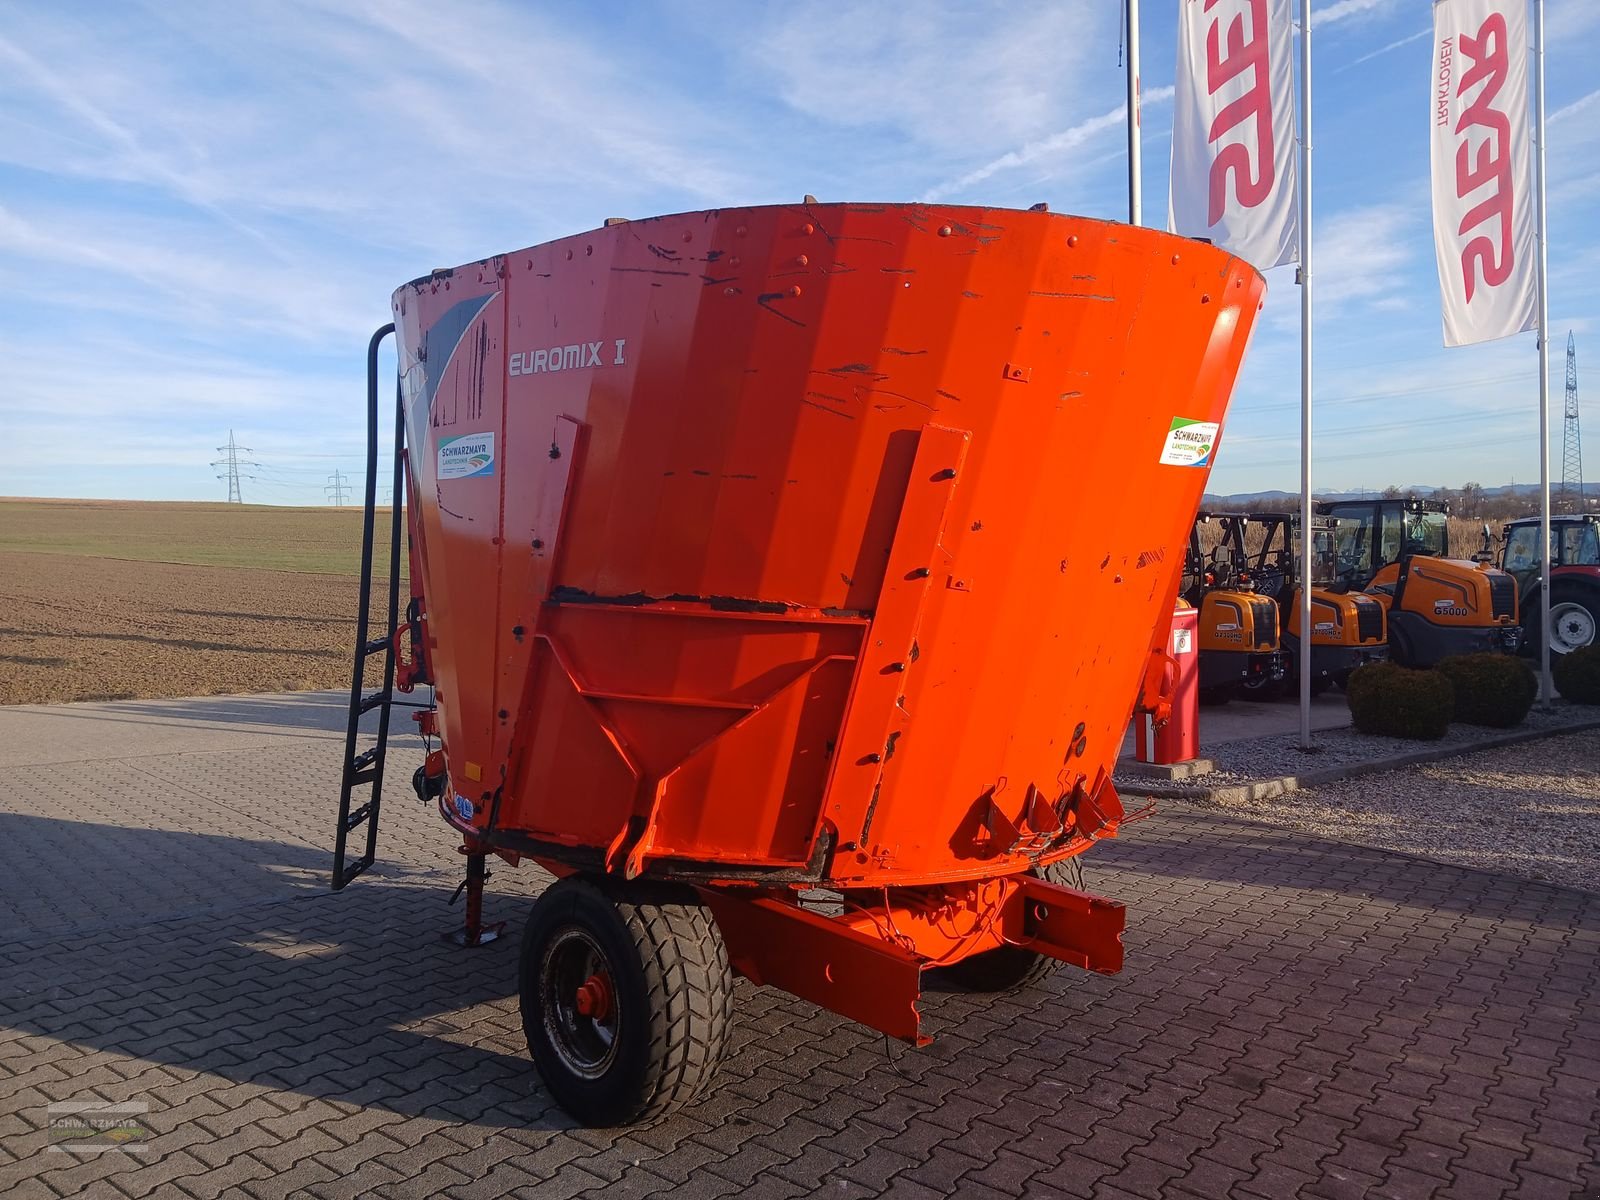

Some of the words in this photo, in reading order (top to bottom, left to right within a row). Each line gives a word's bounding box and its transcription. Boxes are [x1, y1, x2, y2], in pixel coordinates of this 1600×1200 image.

[509, 341, 603, 376] EUROMIX
[441, 444, 487, 457] SCHWARZMAYR
[1434, 606, 1468, 616] G5000
